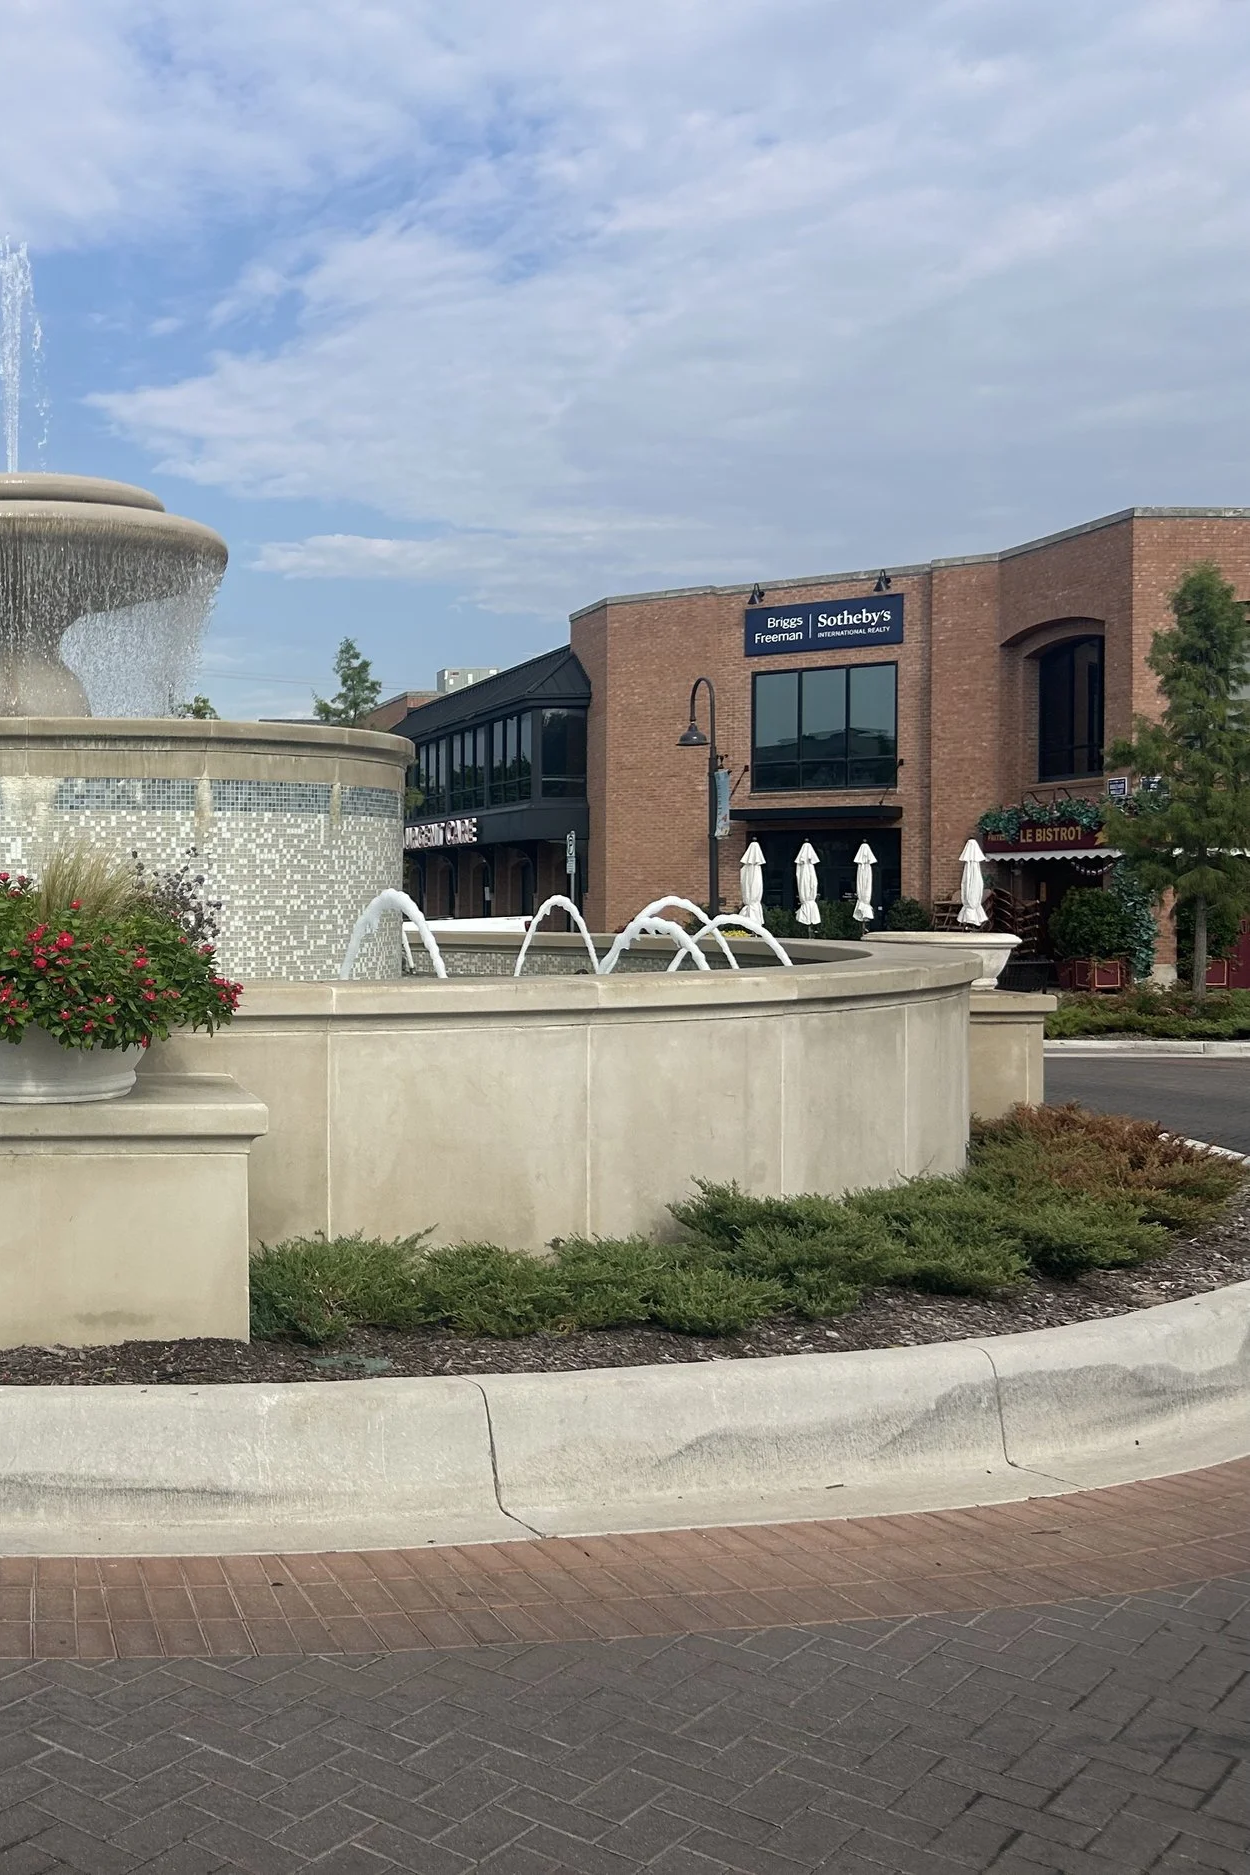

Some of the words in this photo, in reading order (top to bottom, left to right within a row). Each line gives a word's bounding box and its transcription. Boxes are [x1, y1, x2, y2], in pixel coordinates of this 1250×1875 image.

[767, 616, 803, 629] Briggs
[817, 607, 891, 628] Sotheby's
[754, 631, 803, 644] Freeman
[817, 628, 866, 638] INTERNATIONAL
[867, 626, 891, 634] REALTY
[445, 817, 478, 846] CARE
[1020, 829, 1033, 843] LE
[1035, 826, 1082, 842] BISTROT
